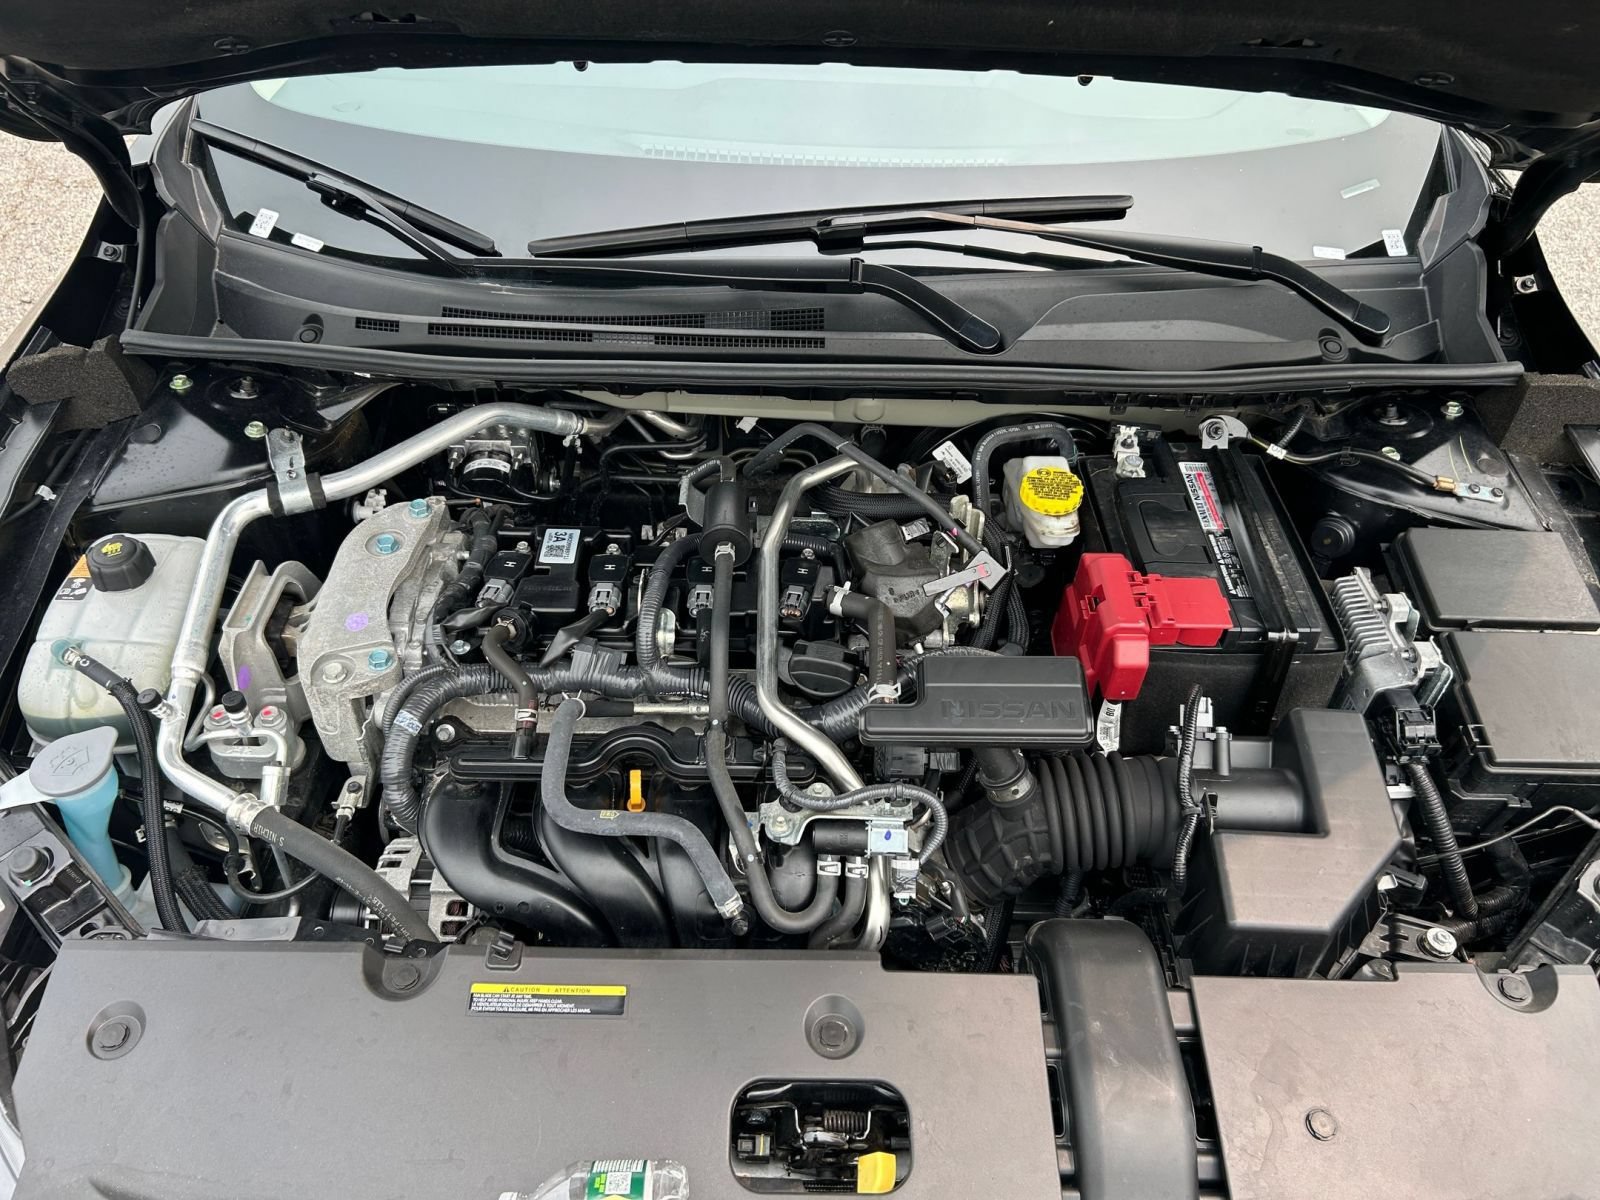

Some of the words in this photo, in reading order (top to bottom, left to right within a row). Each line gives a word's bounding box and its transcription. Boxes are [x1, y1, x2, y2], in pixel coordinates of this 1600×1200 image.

[1185, 473, 1201, 501] NISSAN
[552, 531, 568, 543] 3A
[941, 699, 1077, 719] NISSAN
